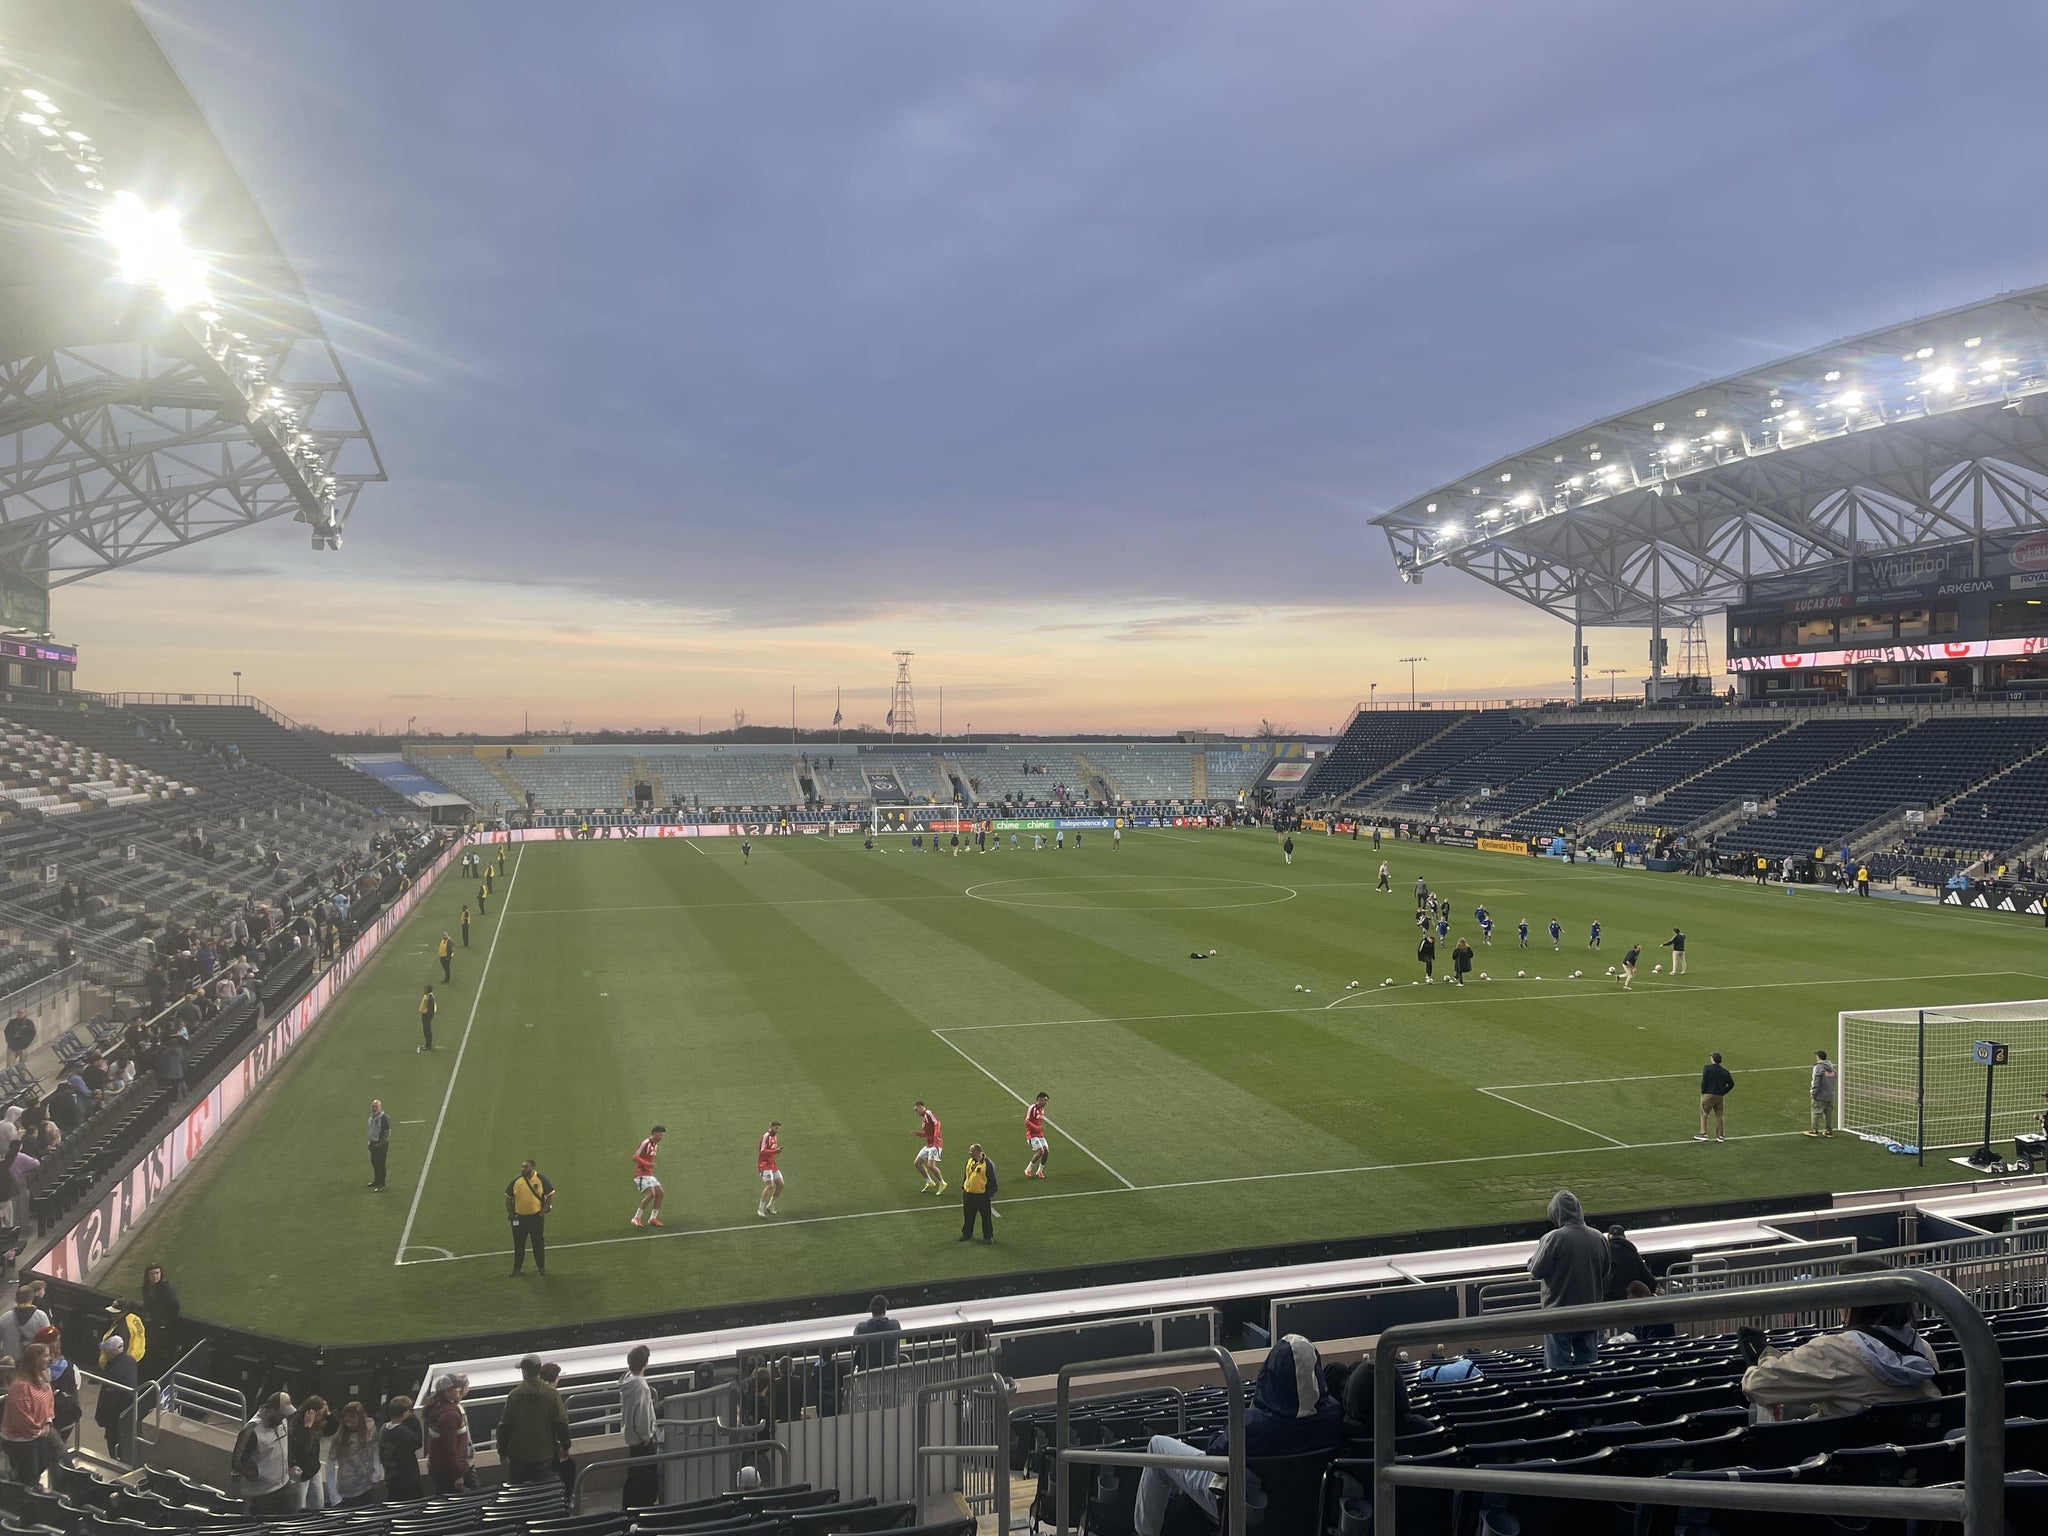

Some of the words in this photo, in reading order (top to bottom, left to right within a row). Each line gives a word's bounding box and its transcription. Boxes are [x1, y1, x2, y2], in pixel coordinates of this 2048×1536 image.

[1871, 551, 1950, 580] Whirlpool
[1937, 580, 1994, 596] ARKEMA
[1795, 598, 1825, 611] LUCAS
[1827, 596, 1842, 607] OIL
[2009, 692, 2022, 700] 107
[996, 821, 1019, 829] chime
[1027, 820, 1050, 829] chime
[1060, 820, 1101, 828] Independence
[1481, 840, 1508, 850] Continental
[1511, 843, 1524, 852] Tire
